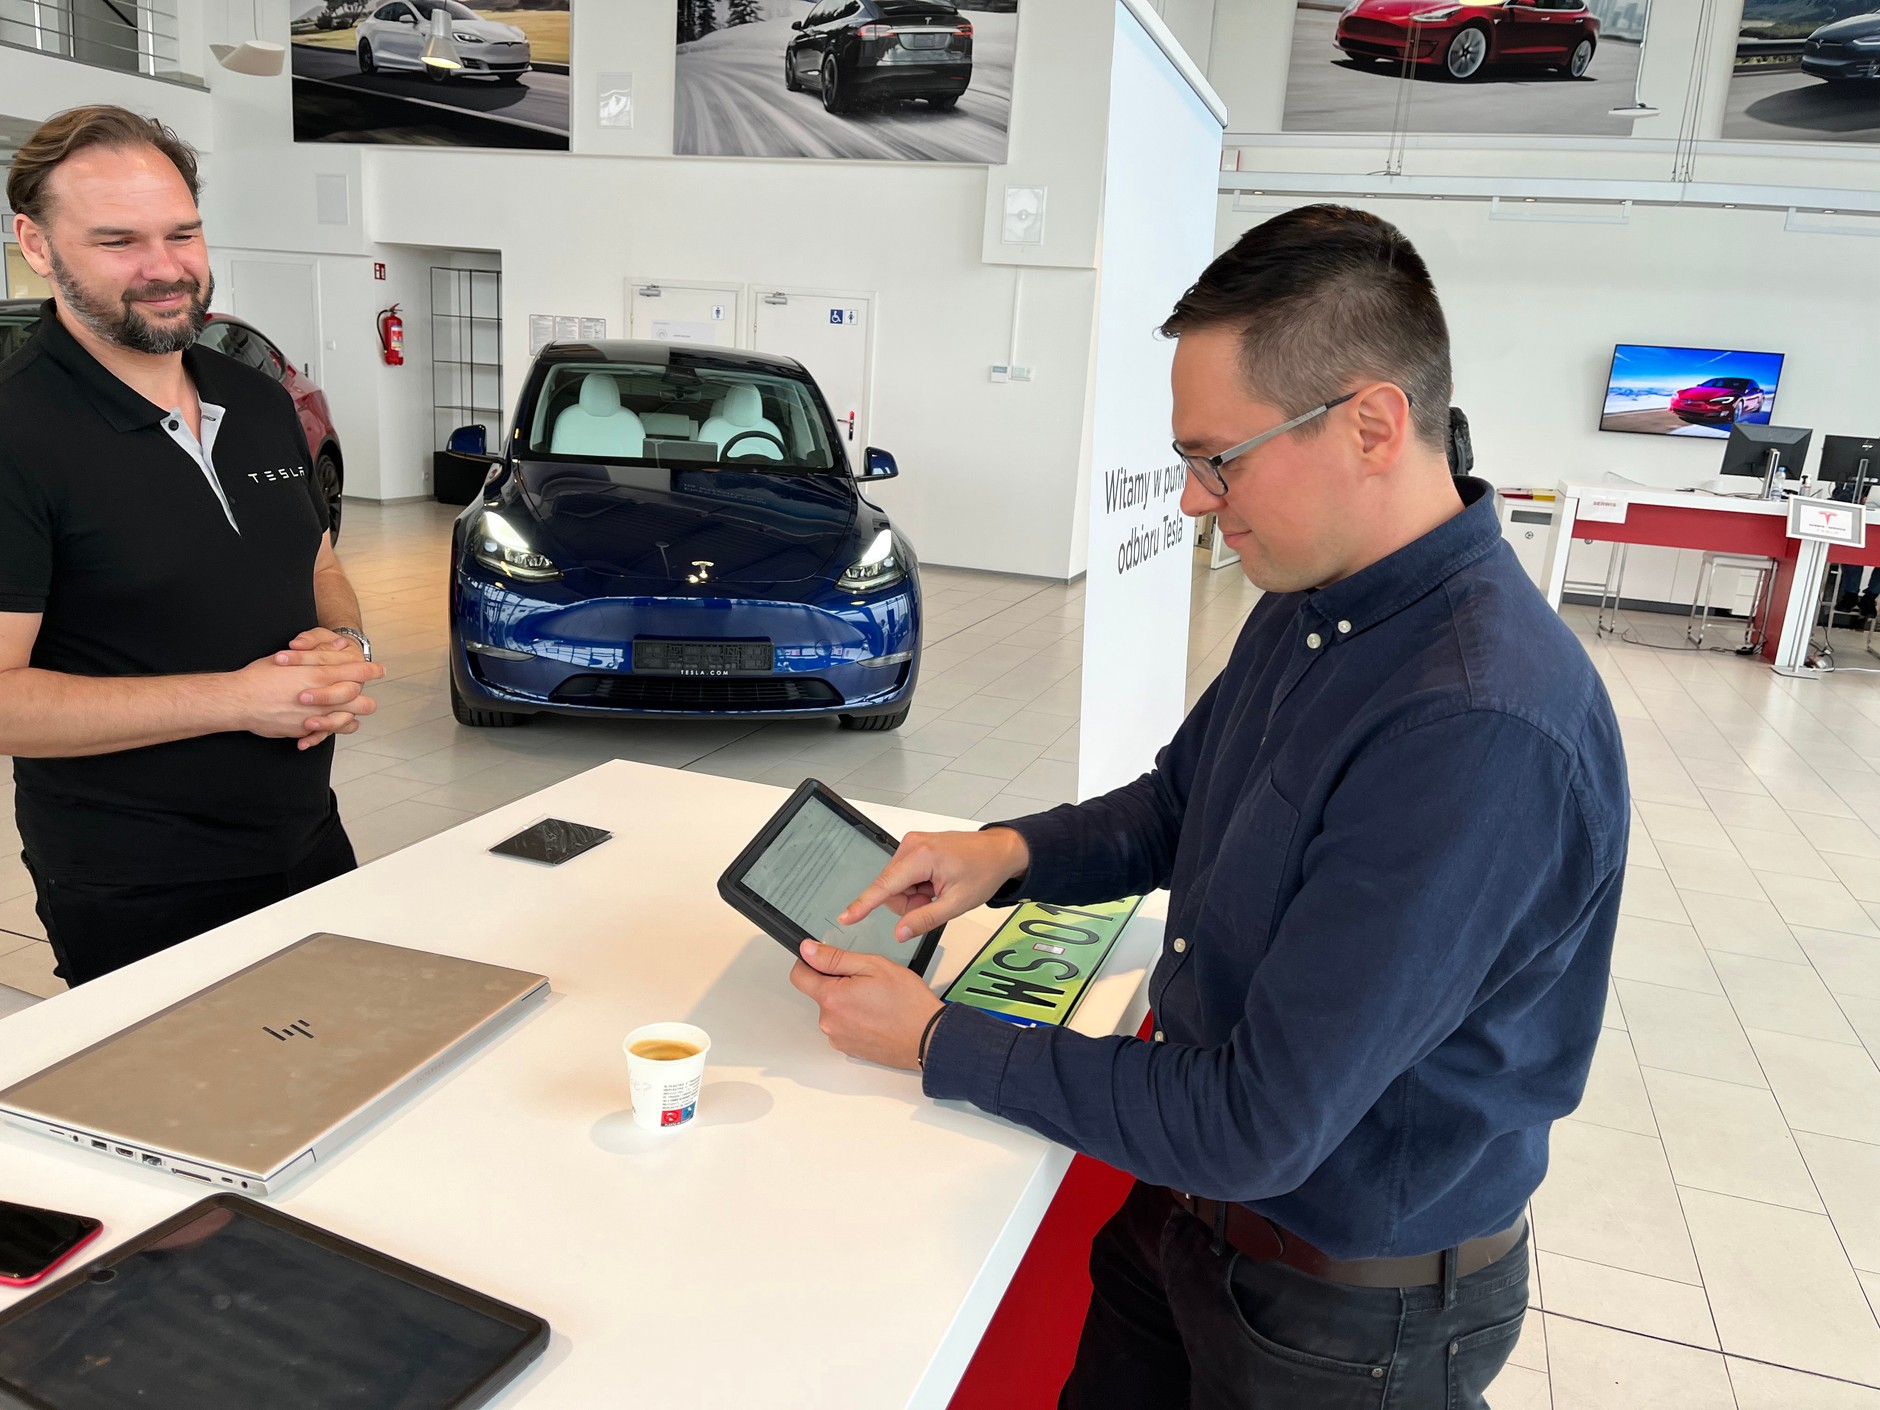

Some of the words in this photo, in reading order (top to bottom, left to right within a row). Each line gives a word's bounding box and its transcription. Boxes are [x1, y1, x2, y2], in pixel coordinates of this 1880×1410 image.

[1105, 466, 1151, 514] Witamy
[1153, 468, 1162, 498] w
[1163, 460, 1188, 503] punk
[1118, 523, 1160, 575] odbioru
[1163, 508, 1184, 551] Tesla
[1018, 899, 1126, 946] 01
[965, 949, 1080, 1009] WS
